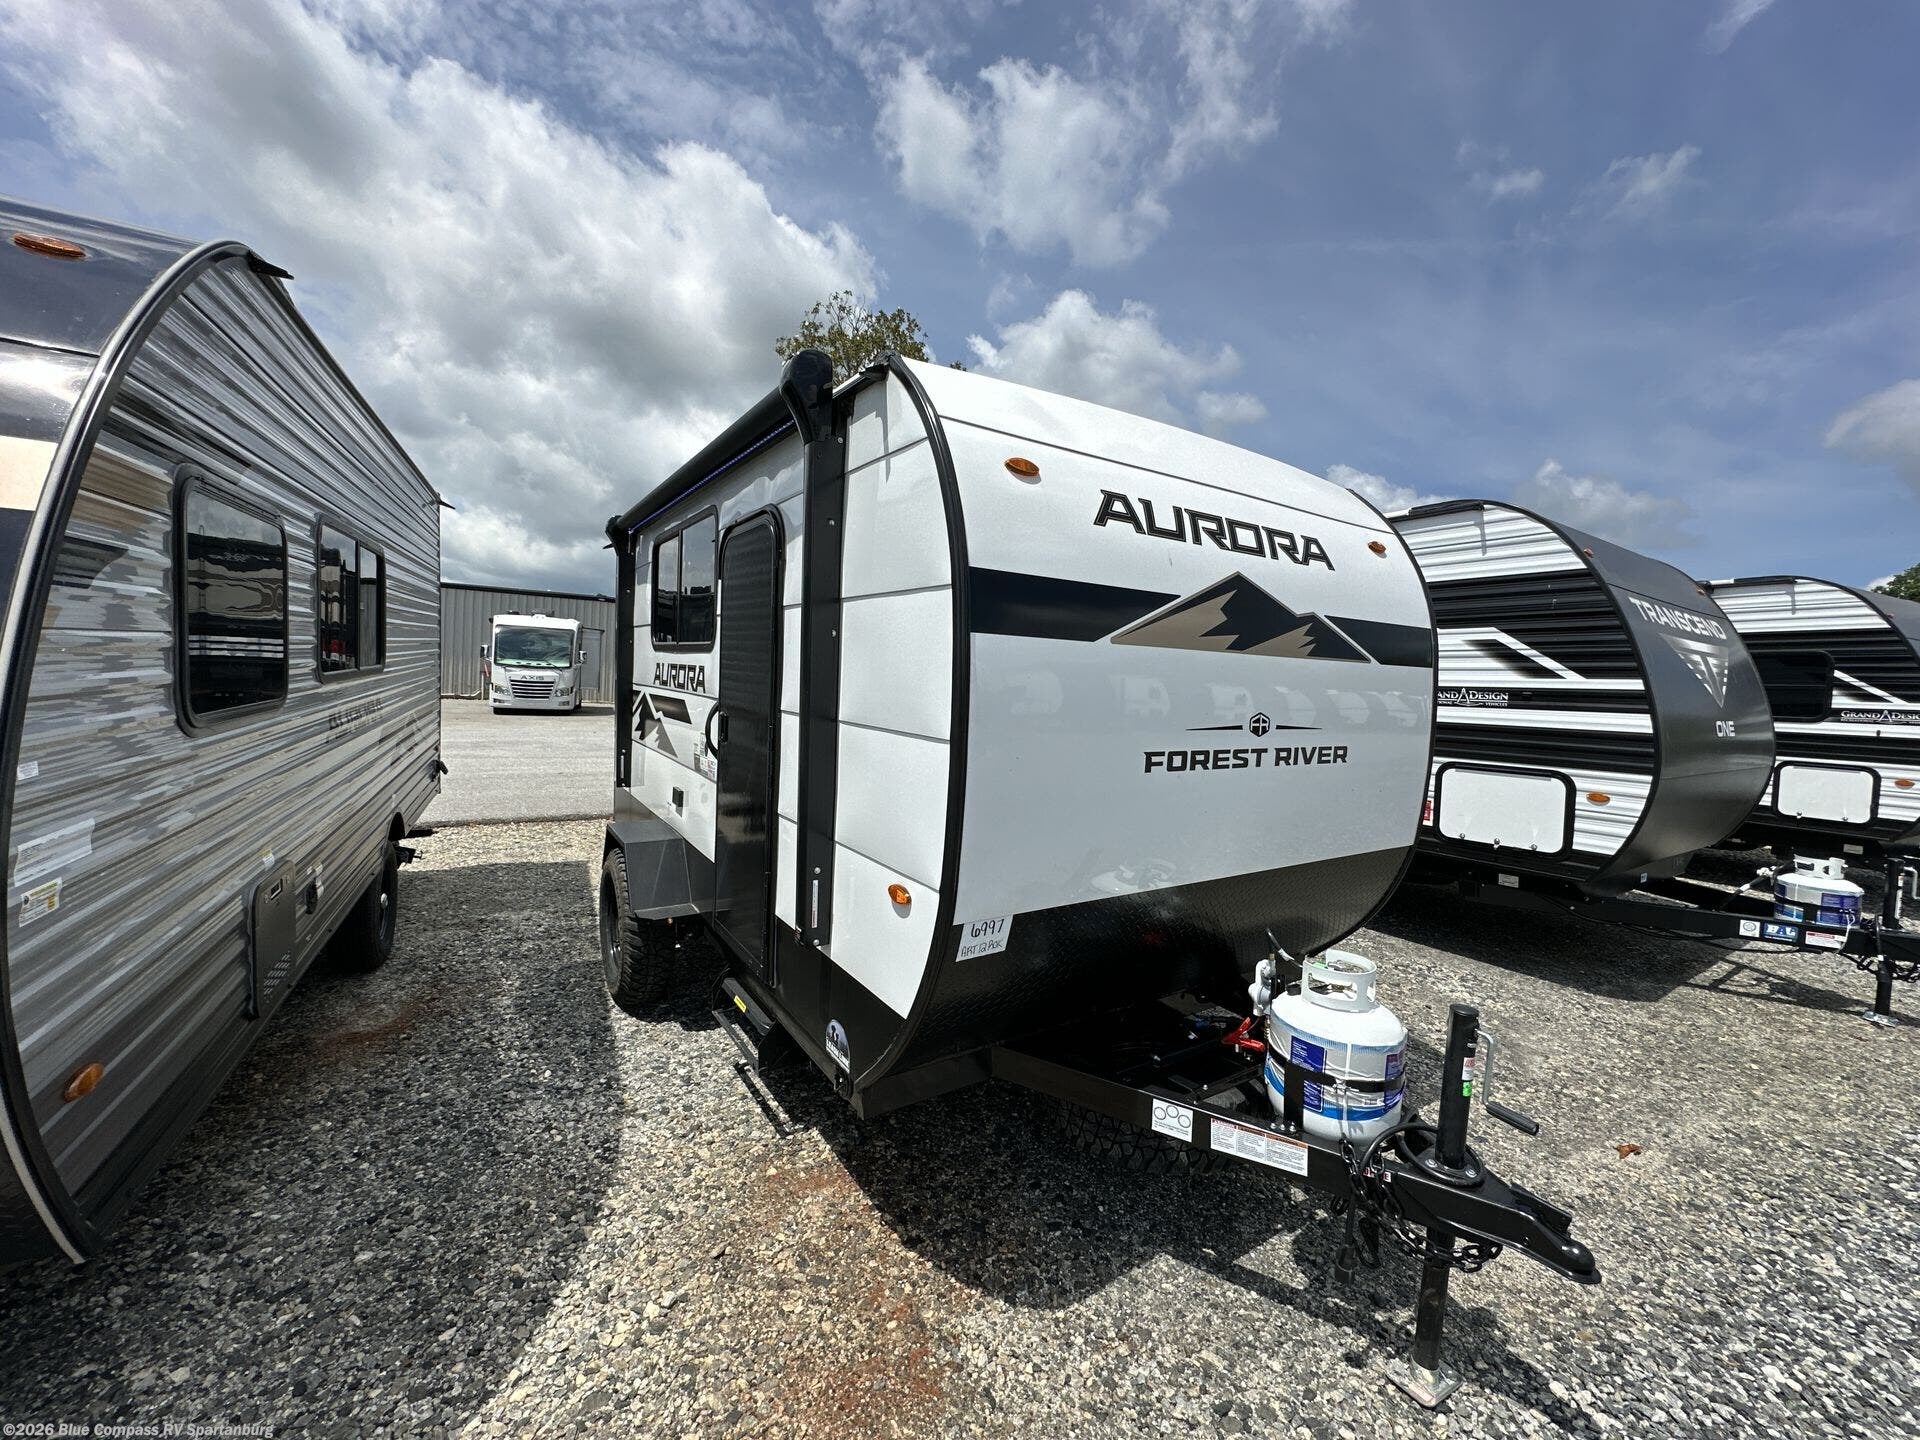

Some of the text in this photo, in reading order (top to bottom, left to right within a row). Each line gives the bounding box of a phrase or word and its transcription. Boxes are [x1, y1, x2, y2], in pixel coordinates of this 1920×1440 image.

[1093, 489, 1336, 571] AURORA
[1628, 597, 1727, 640] TRANSCEND
[653, 662, 706, 693] AURORA
[1438, 690, 1509, 700] AND DESIGN
[1841, 710, 1920, 720] GRAND DESIG
[1715, 720, 1735, 737] ONE
[1143, 746, 1348, 773] FOREST RIVER
[971, 919, 1004, 938] 6997
